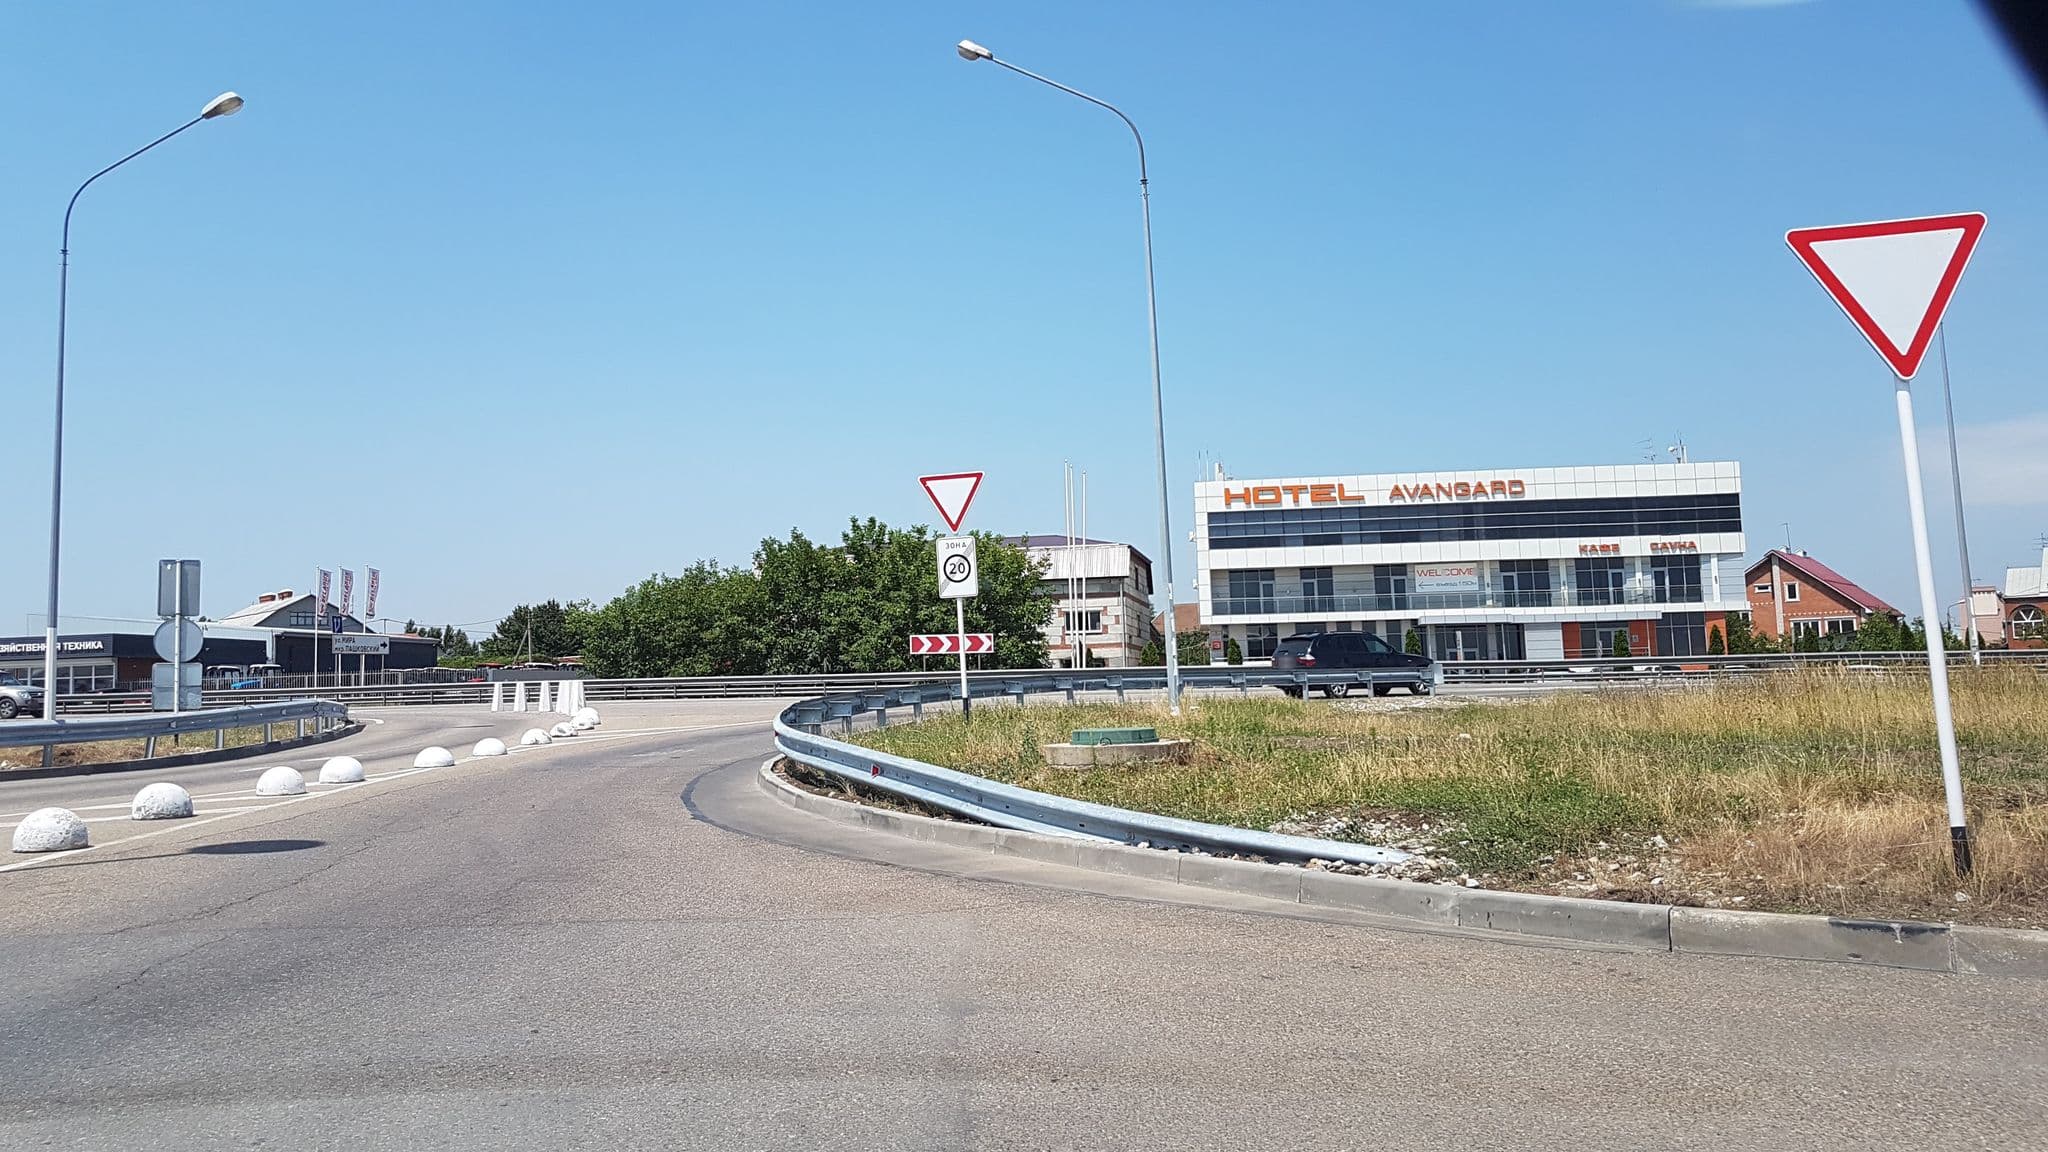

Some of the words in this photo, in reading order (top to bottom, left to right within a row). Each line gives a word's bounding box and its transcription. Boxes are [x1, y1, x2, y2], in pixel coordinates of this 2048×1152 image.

[1224, 483, 1365, 505] HOTEL
[1389, 480, 1525, 501] AVANGARD
[1579, 543, 1620, 554] КАФЕ
[1650, 541, 1698, 553] САУНА
[949, 562, 966, 574] 20
[0, 643, 61, 652] ЗЯЙСТВЕННЯ
[63, 641, 103, 650] ТЕХНИКА
